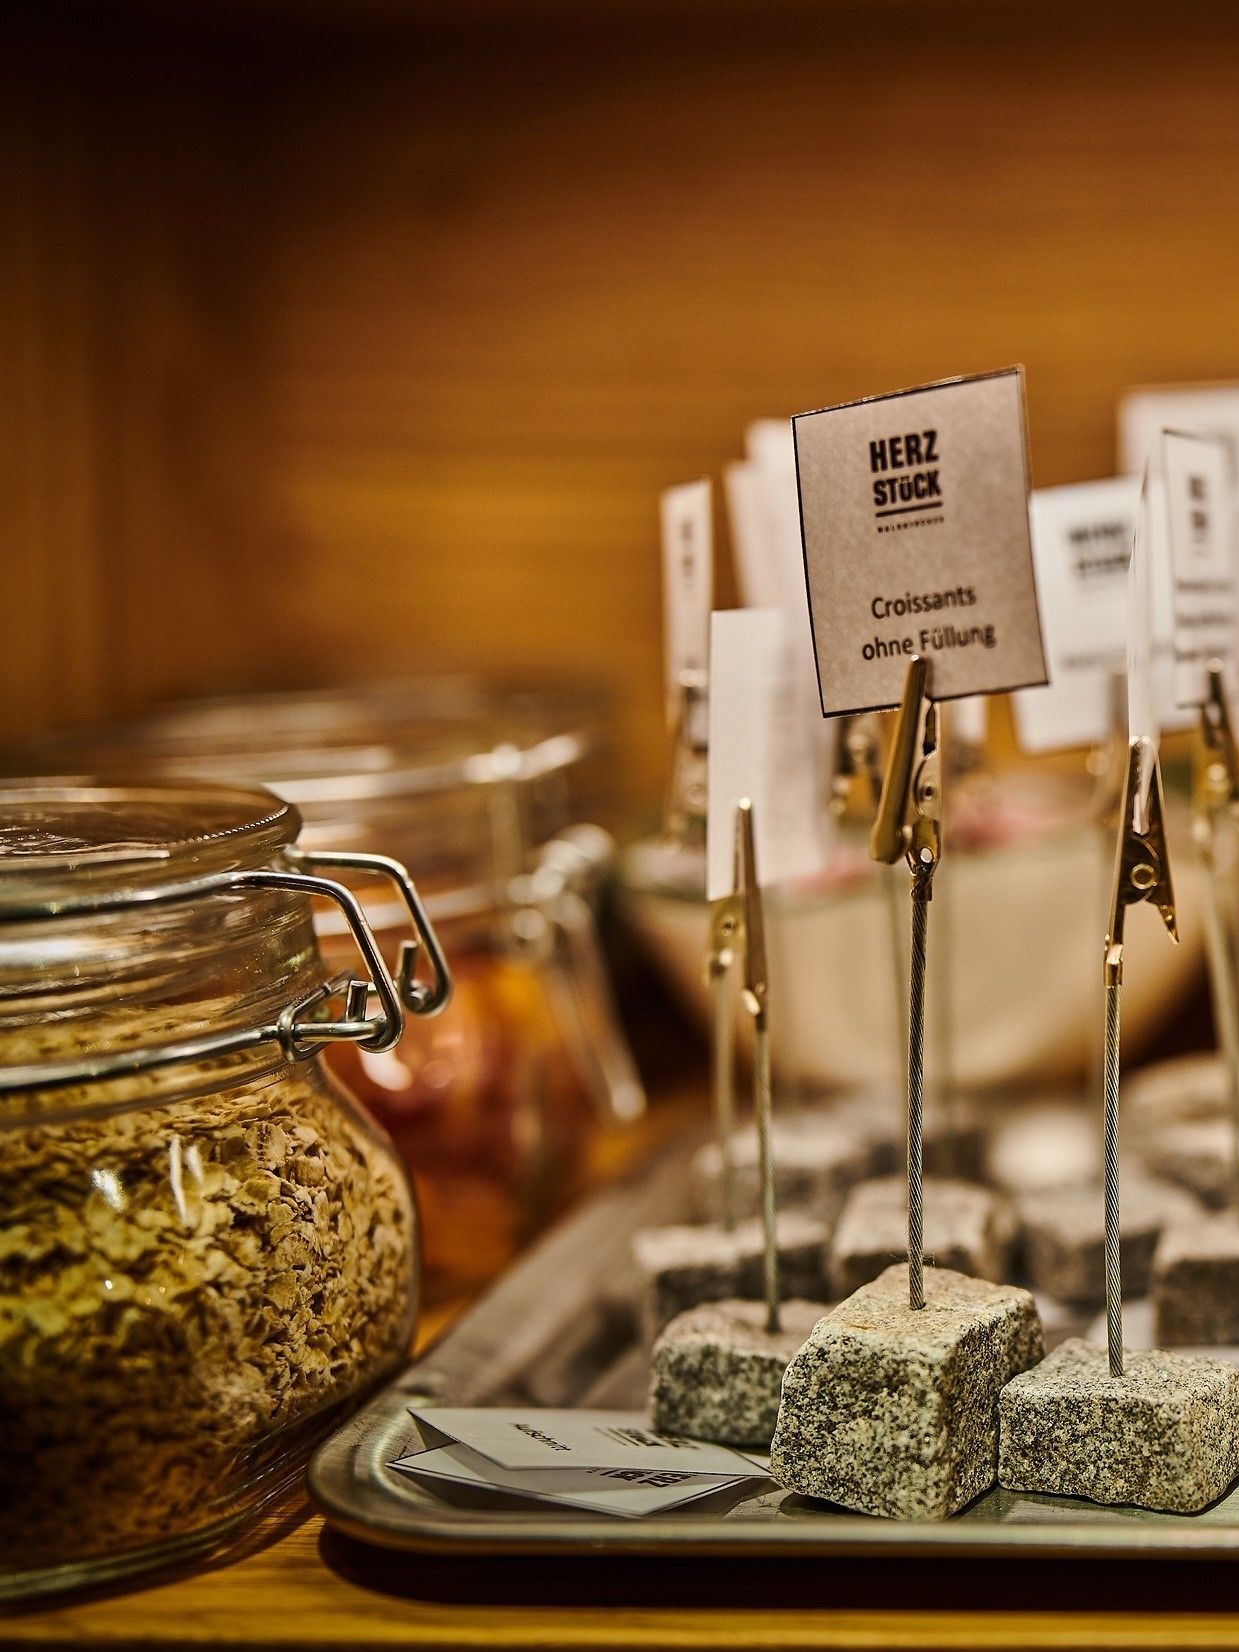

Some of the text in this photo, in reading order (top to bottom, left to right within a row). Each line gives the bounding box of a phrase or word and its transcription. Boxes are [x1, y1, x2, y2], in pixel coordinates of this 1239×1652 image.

[870, 428, 939, 473] HERZ
[871, 587, 977, 619] Croissants
[862, 624, 997, 661] ohne Füllung
